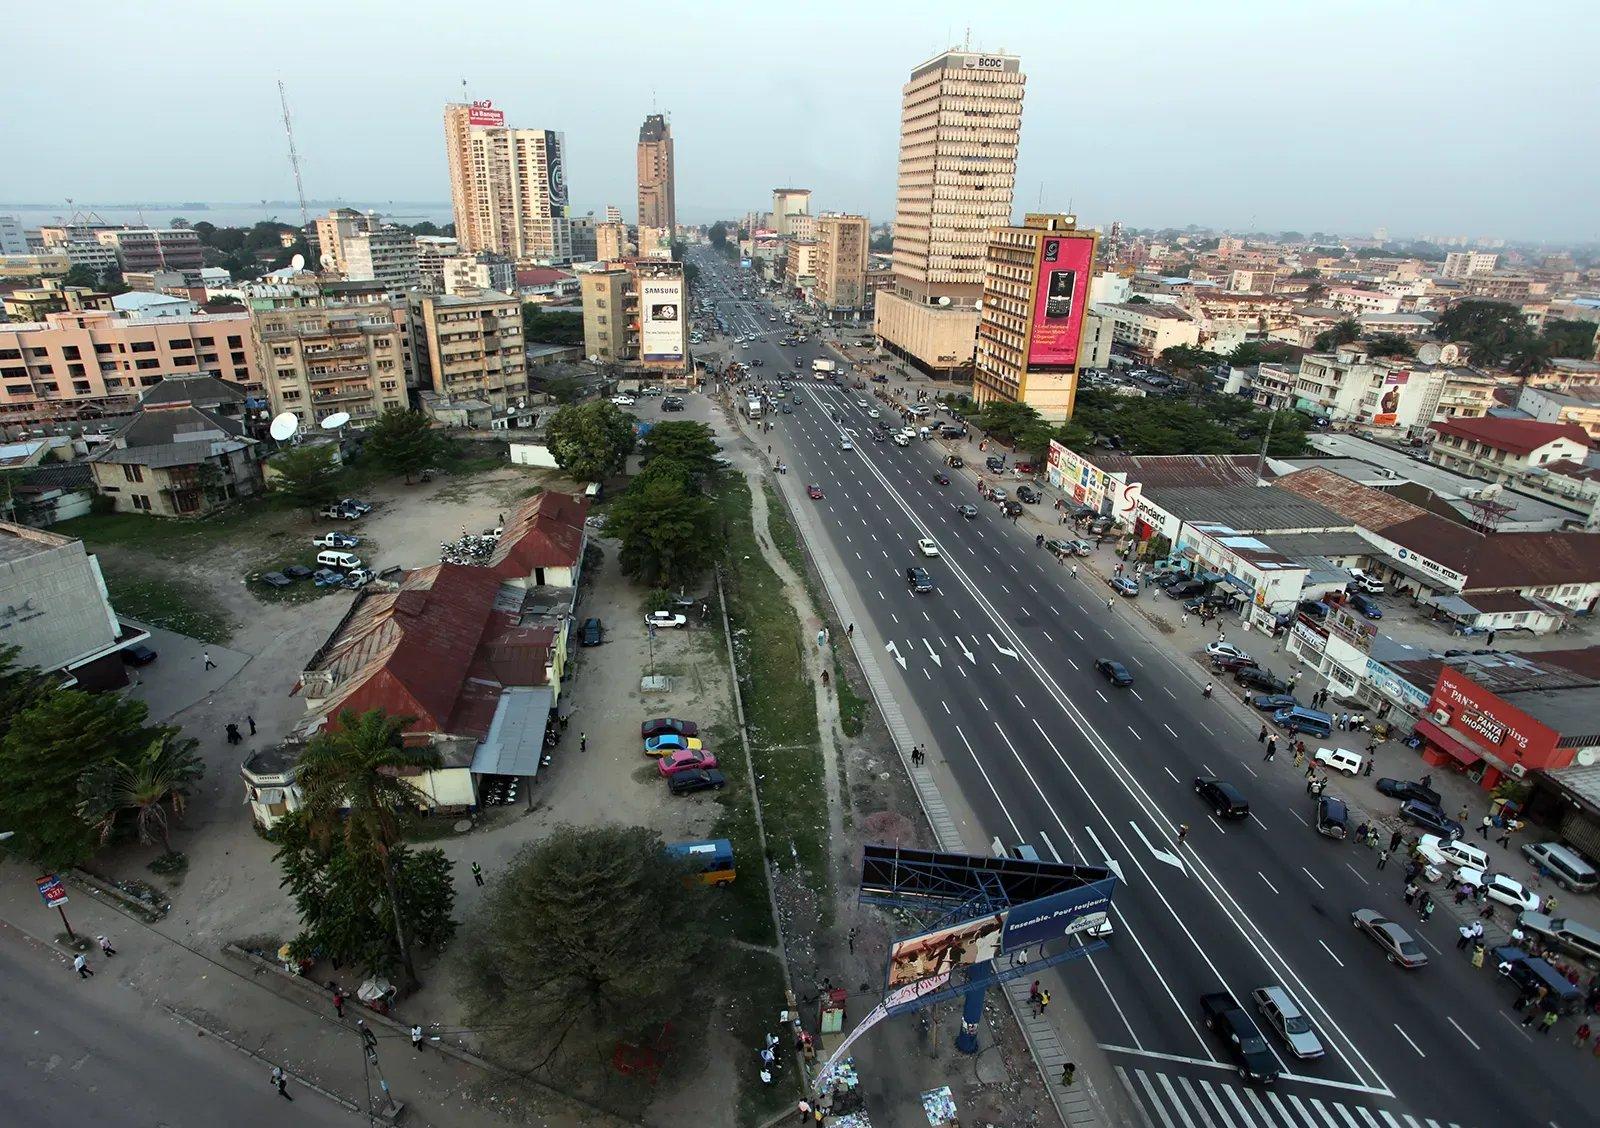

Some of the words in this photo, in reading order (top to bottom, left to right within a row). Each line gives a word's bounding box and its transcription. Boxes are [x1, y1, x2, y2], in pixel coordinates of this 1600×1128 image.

[979, 58, 1001, 67] BCDC
[1121, 485, 1166, 524] Standard
[1366, 659, 1389, 675] BABY
[1398, 680, 1430, 705] CENTER
[1460, 715, 1500, 744] SHOPPING
[1477, 716, 1502, 736] PANTA
[1009, 915, 1051, 931] Ensemble.
[1053, 908, 1072, 918] Pour
[1074, 898, 1109, 911] toujours.
